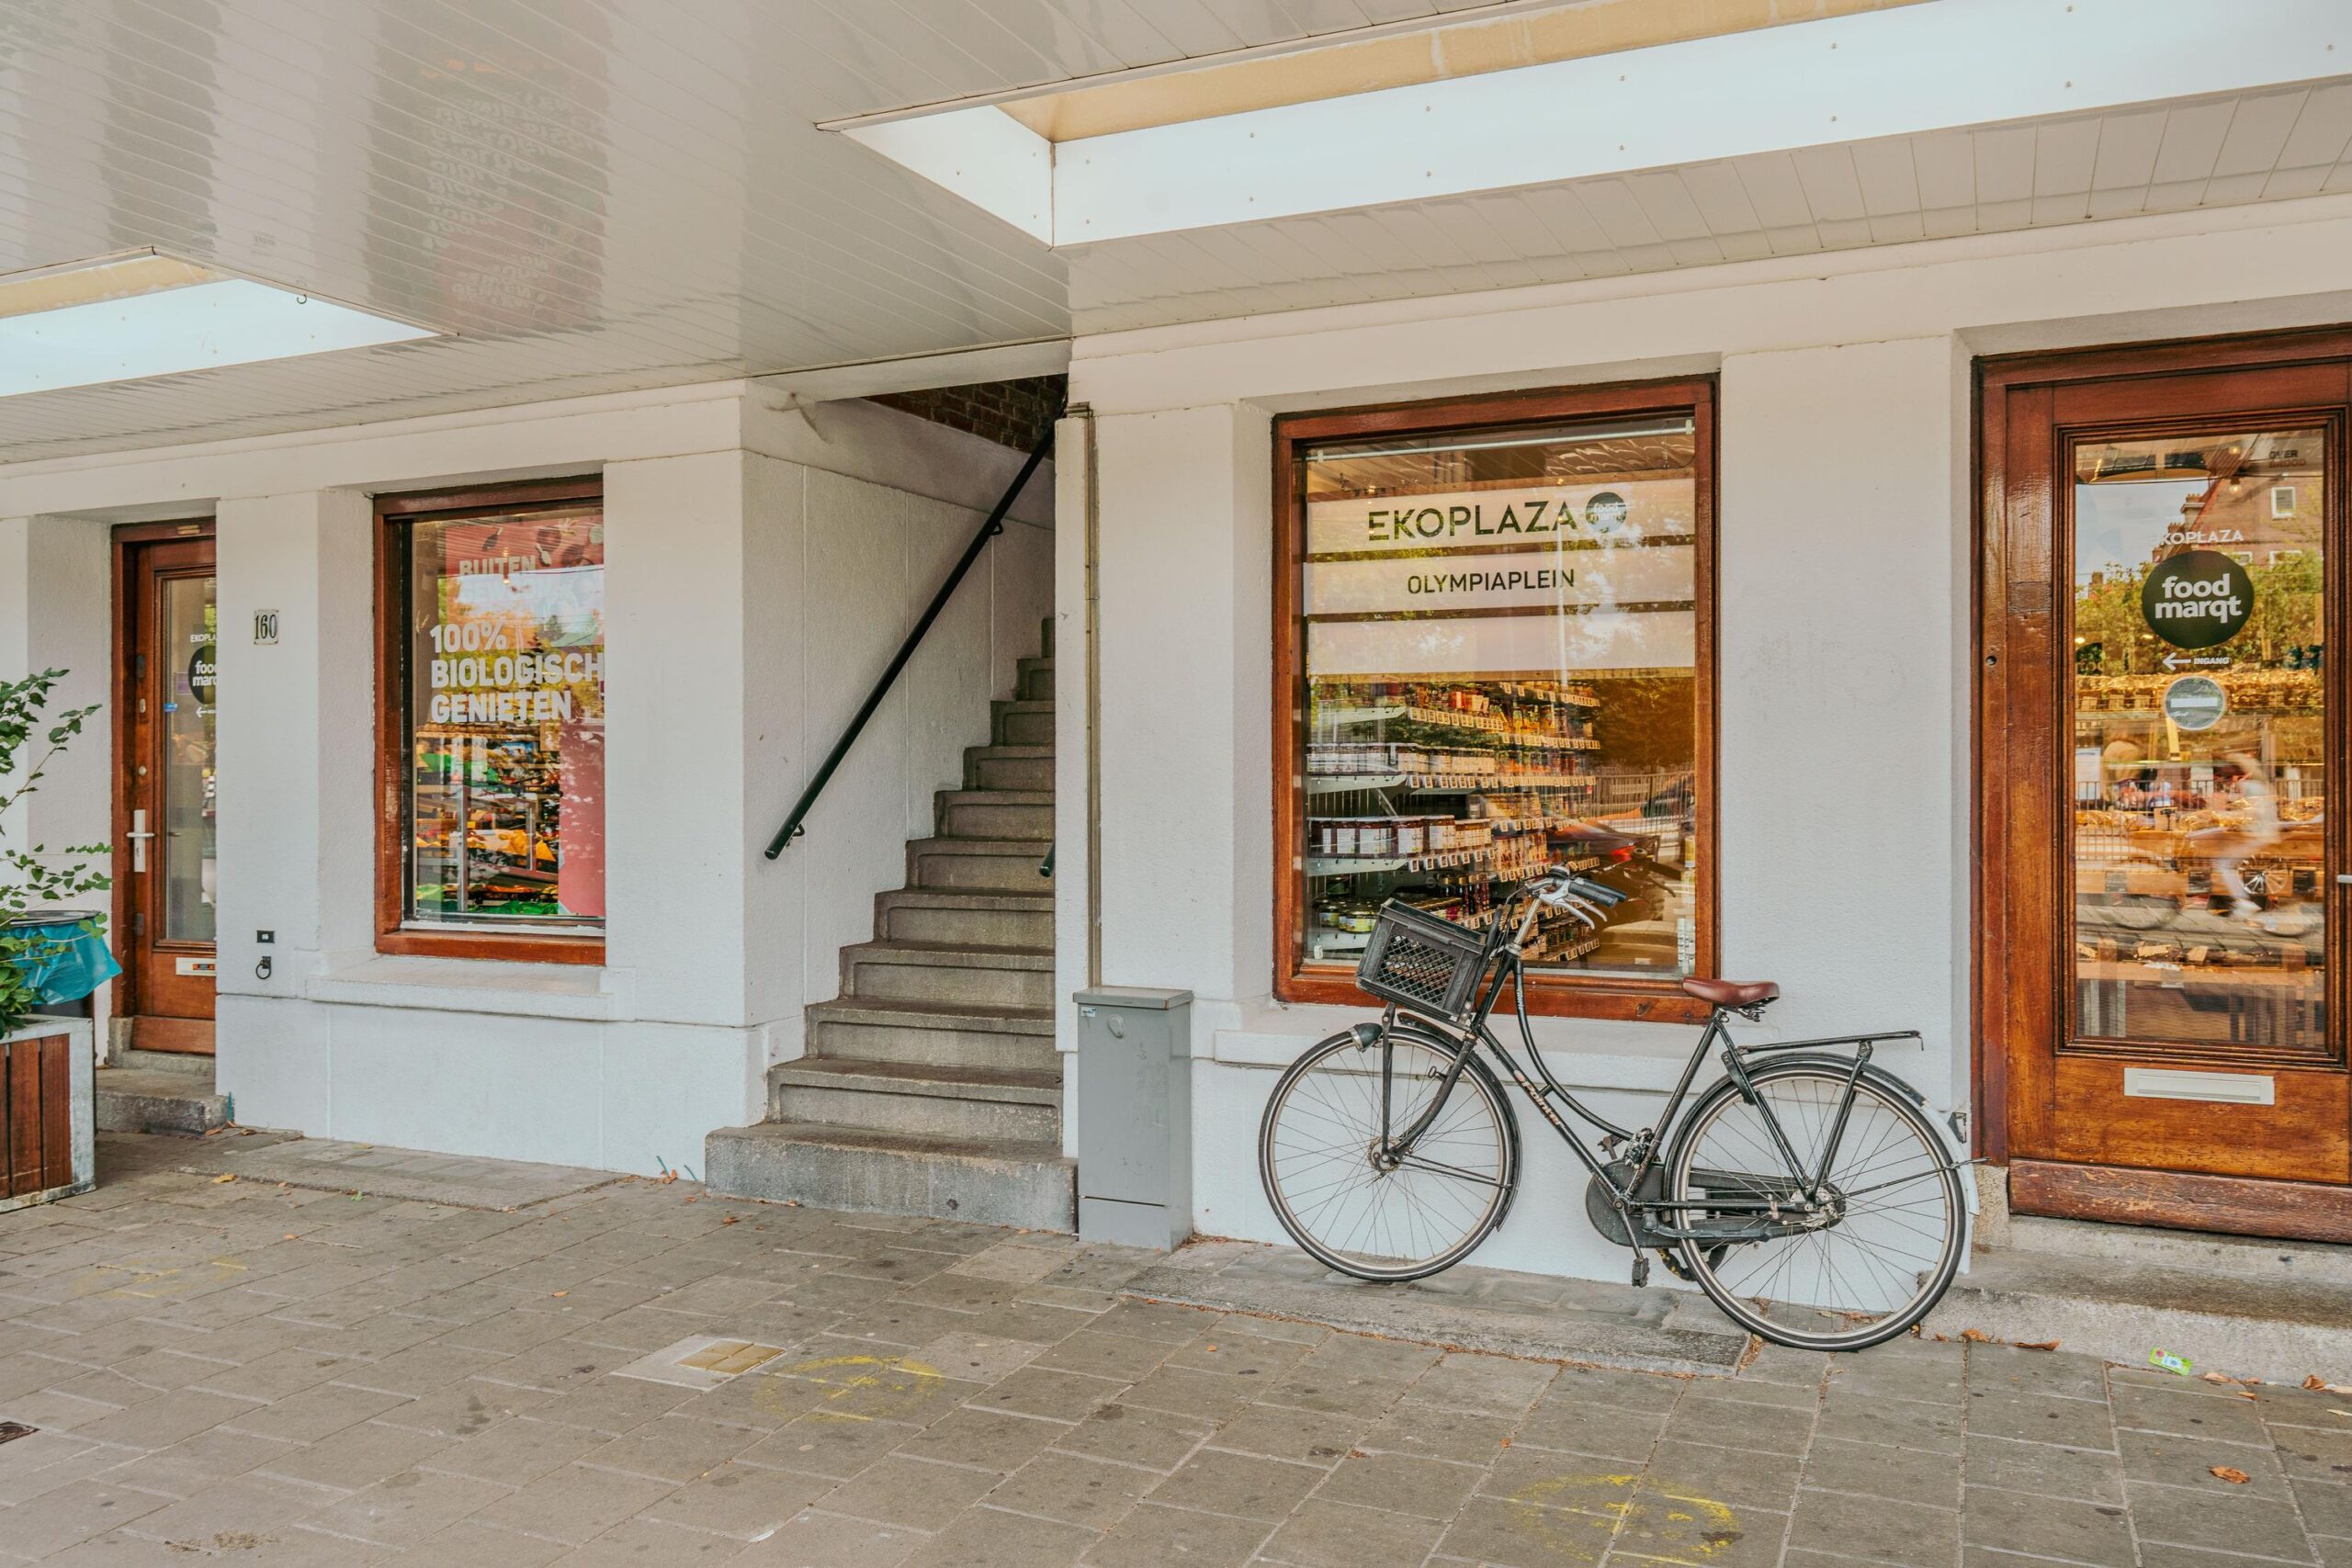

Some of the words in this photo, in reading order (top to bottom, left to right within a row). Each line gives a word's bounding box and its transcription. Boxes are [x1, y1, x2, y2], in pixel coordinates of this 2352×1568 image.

[1369, 500, 1578, 542] EKOPLAZA
[2156, 529, 2245, 546] KOPLAZA
[459, 555, 537, 576] BUITEN
[1408, 569, 1575, 594] OLYMPIAPLEIN
[2161, 573, 2231, 599] food
[2154, 595, 2243, 624] marqt
[254, 614, 277, 639] 160
[430, 621, 509, 653] 100%
[431, 651, 605, 688] BIOLOGISCH
[2193, 657, 2230, 665] INGANG
[431, 690, 572, 723] GENIETEN
[1521, 1080, 1561, 1125] Pointer
